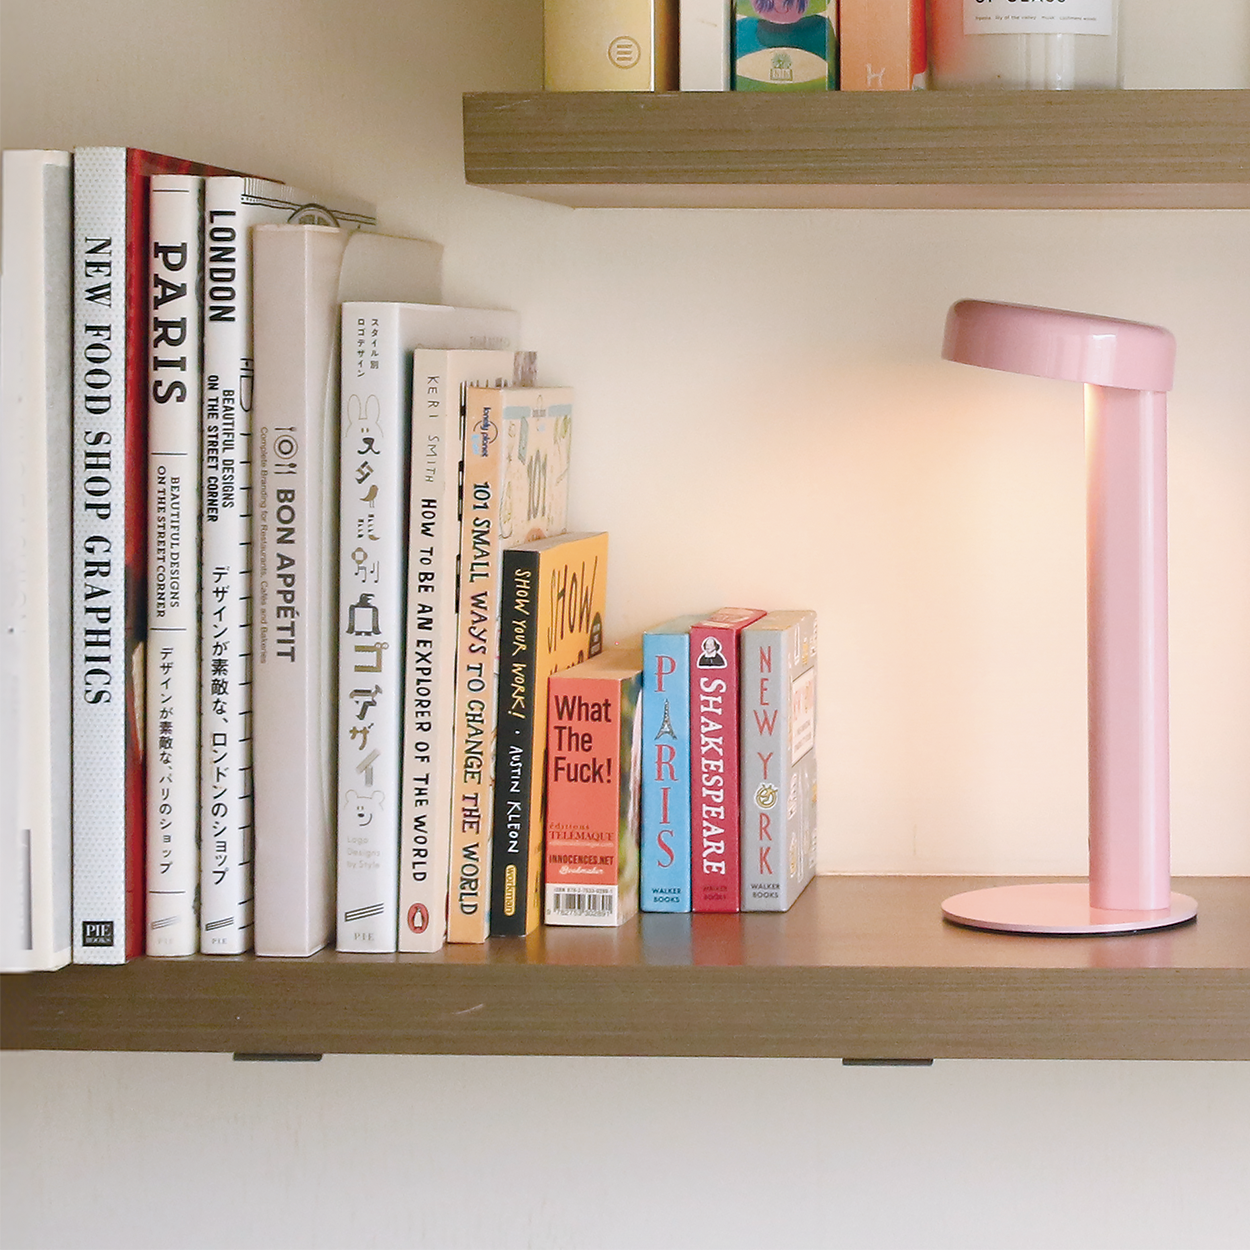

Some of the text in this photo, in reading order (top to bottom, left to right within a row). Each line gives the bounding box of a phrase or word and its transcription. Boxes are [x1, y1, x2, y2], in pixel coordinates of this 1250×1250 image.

[209, 209, 236, 322] LONDON
[153, 241, 188, 405] PARIS
[356, 318, 367, 379] ロゴデザイン
[369, 318, 381, 370] スタイル別
[206, 374, 219, 523] ON THE STREET CORNER
[221, 389, 235, 509] BEAUTIFUL DESIGNS
[260, 426, 269, 467] Complete
[425, 375, 440, 483] KERI SMITH
[480, 406, 492, 457] lonely planet
[84, 236, 112, 705] NEW FOOD SHOP GRAPHICS
[260, 470, 268, 508] Branding
[157, 465, 167, 618] ON THE STREET CORNER
[170, 476, 180, 608] BEAUTIFUL DESIGNS
[260, 510, 268, 521] for
[276, 489, 300, 663] BON APPÉTIT
[547, 556, 598, 655] SHOW
[260, 608, 268, 624] and
[411, 498, 438, 883] HOW TO BE AN EXPLORER OF THE WORLD
[459, 482, 491, 916] 101 SMALL WAYS TO CHANGE THE WORLD
[505, 568, 532, 854] SHOW YOUR WORK! AUSTIN KLEON
[553, 694, 612, 723] What
[753, 645, 778, 737] NEW
[211, 565, 230, 886] デザインが素敵な、ロンドンのショップ
[553, 725, 594, 753] The
[553, 756, 612, 784] Fuck!
[699, 676, 727, 876] SHAKESPEARE
[549, 854, 615, 866] INNOCENCES.NET
[750, 883, 782, 891] WALKER
[504, 867, 516, 916] workman
[651, 887, 682, 895] WALKER
[752, 891, 780, 900] BOOKS
[87, 924, 112, 937] PIE
[353, 932, 375, 942] PIE
